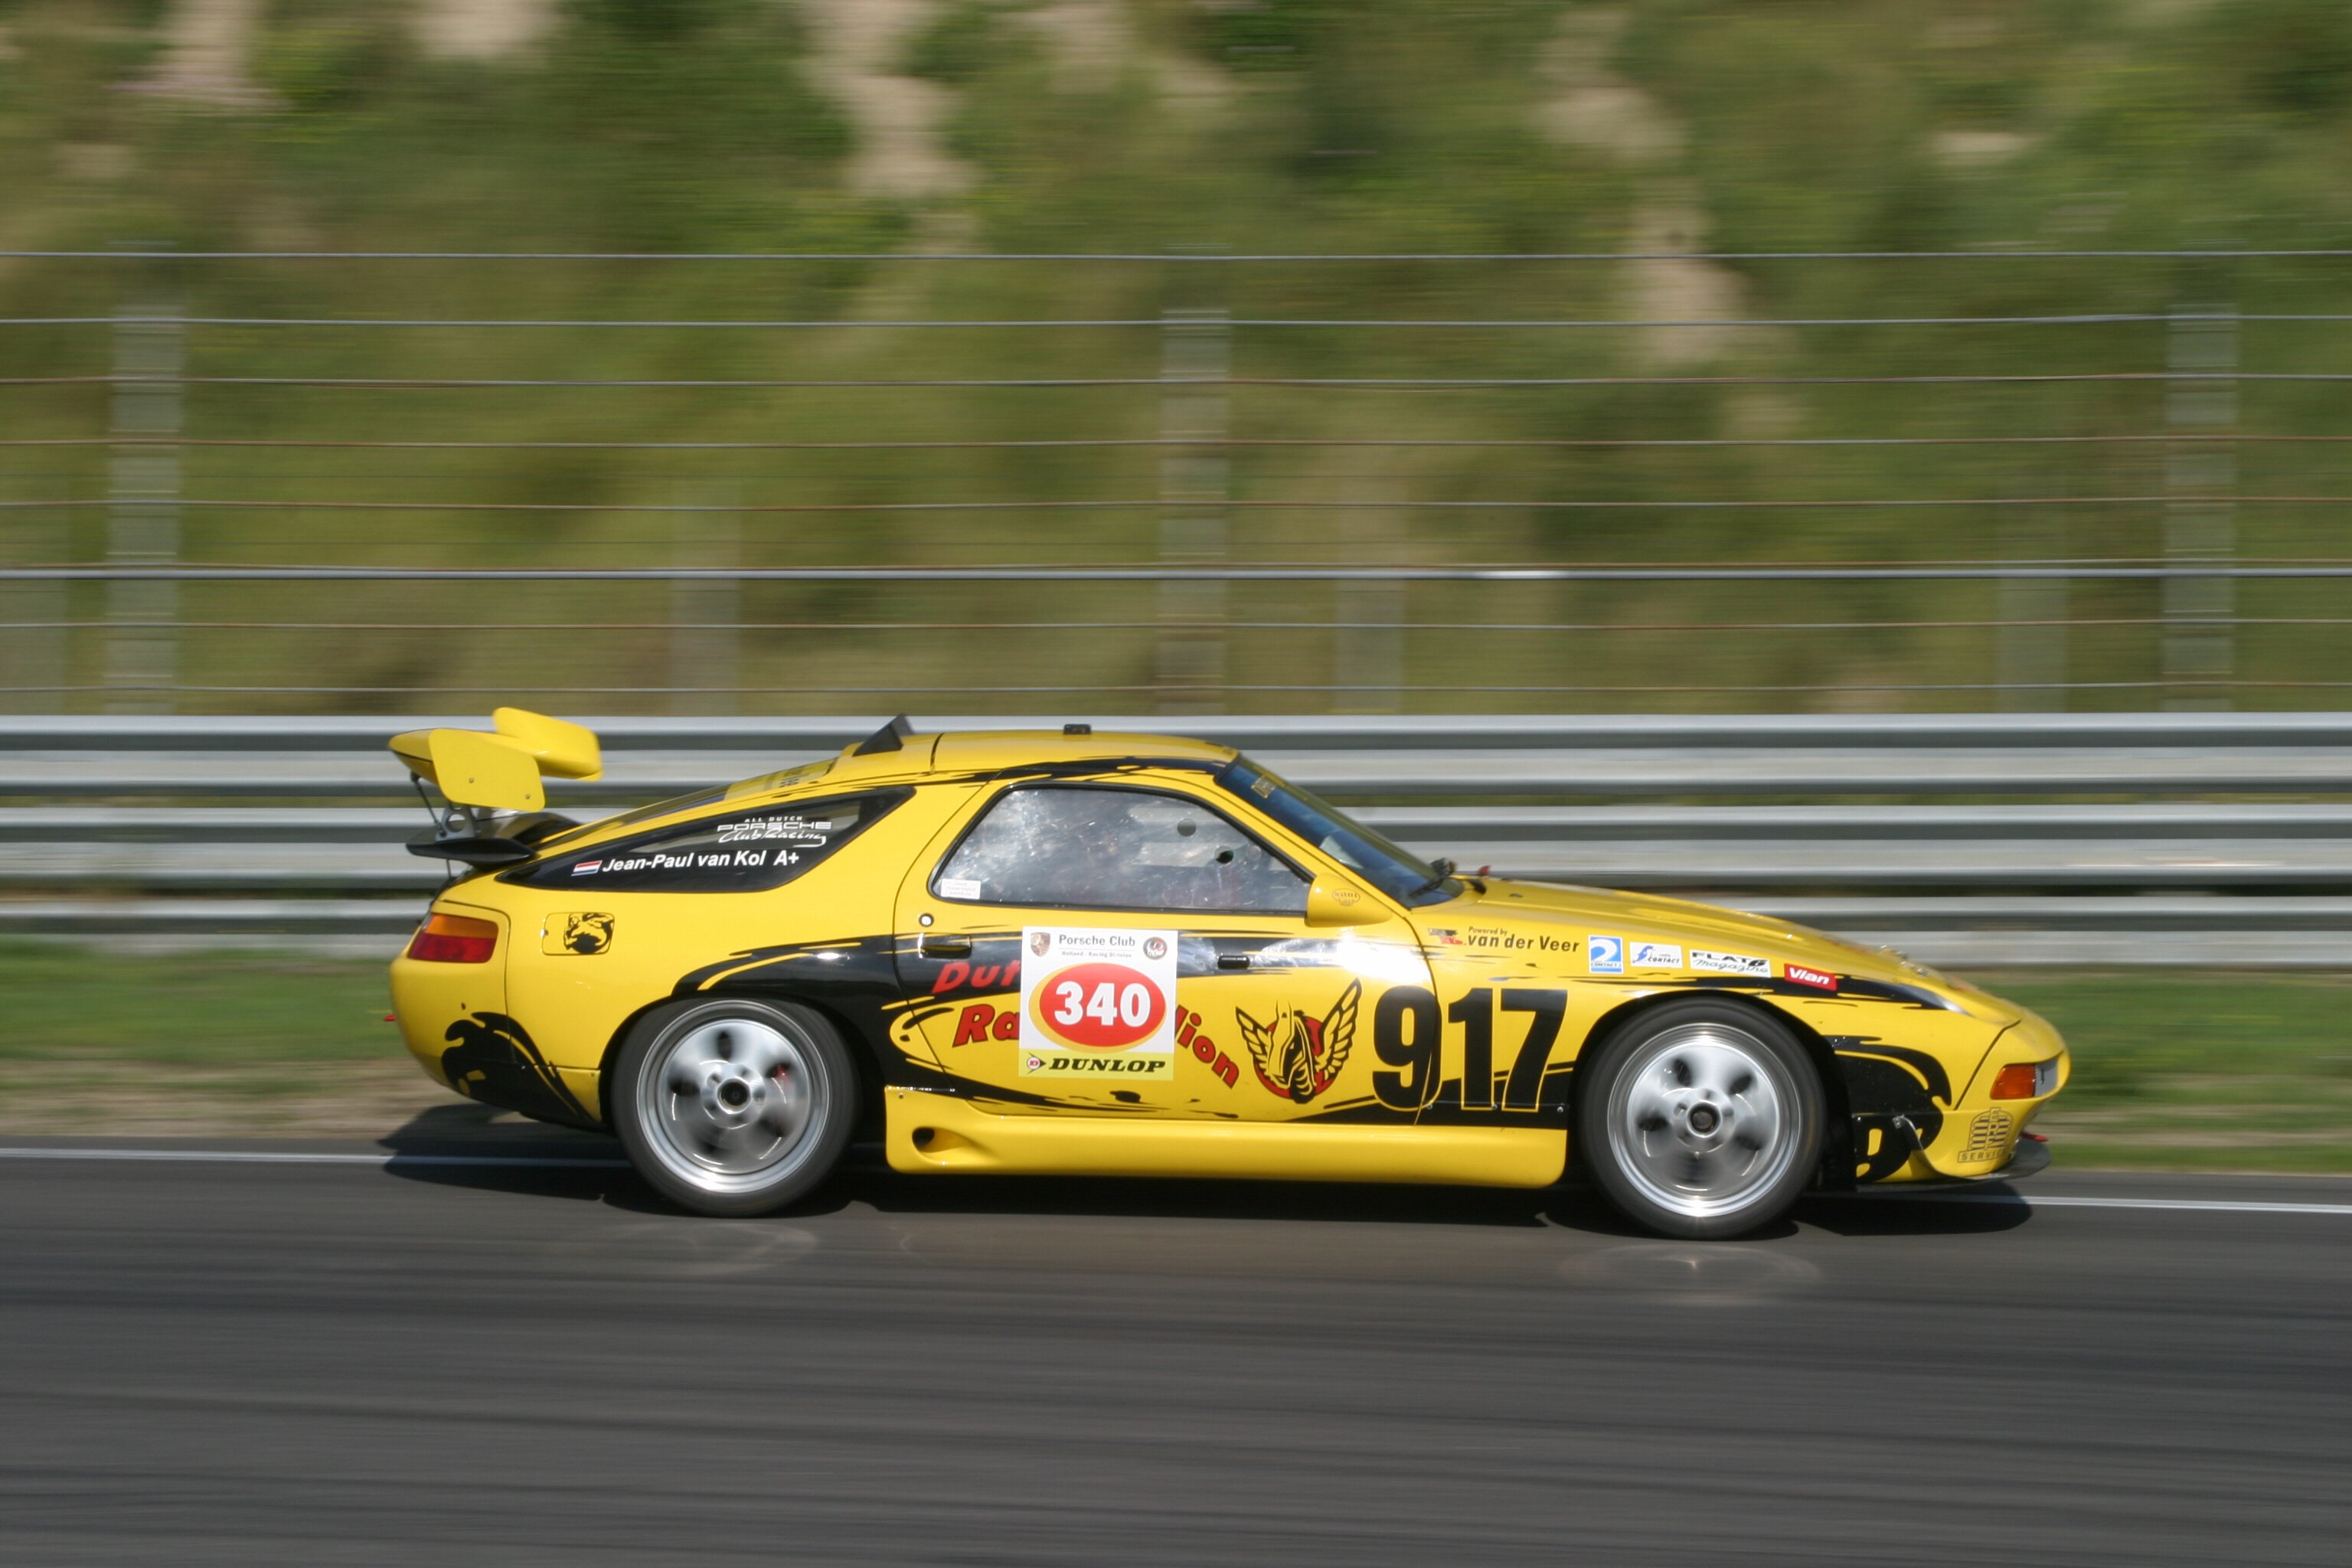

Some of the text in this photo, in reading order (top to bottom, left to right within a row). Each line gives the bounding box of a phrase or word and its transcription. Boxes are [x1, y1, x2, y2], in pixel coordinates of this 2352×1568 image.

[717, 822, 832, 832] PORSCHE
[602, 849, 799, 873] Jean-Paul van Kol A+
[1059, 933, 1135, 946] Porsche Club
[1468, 926, 1498, 935] Powered
[1468, 934, 1579, 952] van der Veer
[931, 959, 1021, 994] Dut
[1788, 967, 1830, 985] Vlan
[1054, 981, 1151, 1027] 340
[1372, 985, 1568, 1113] 917
[1048, 1057, 1166, 1073] DUNLOP
